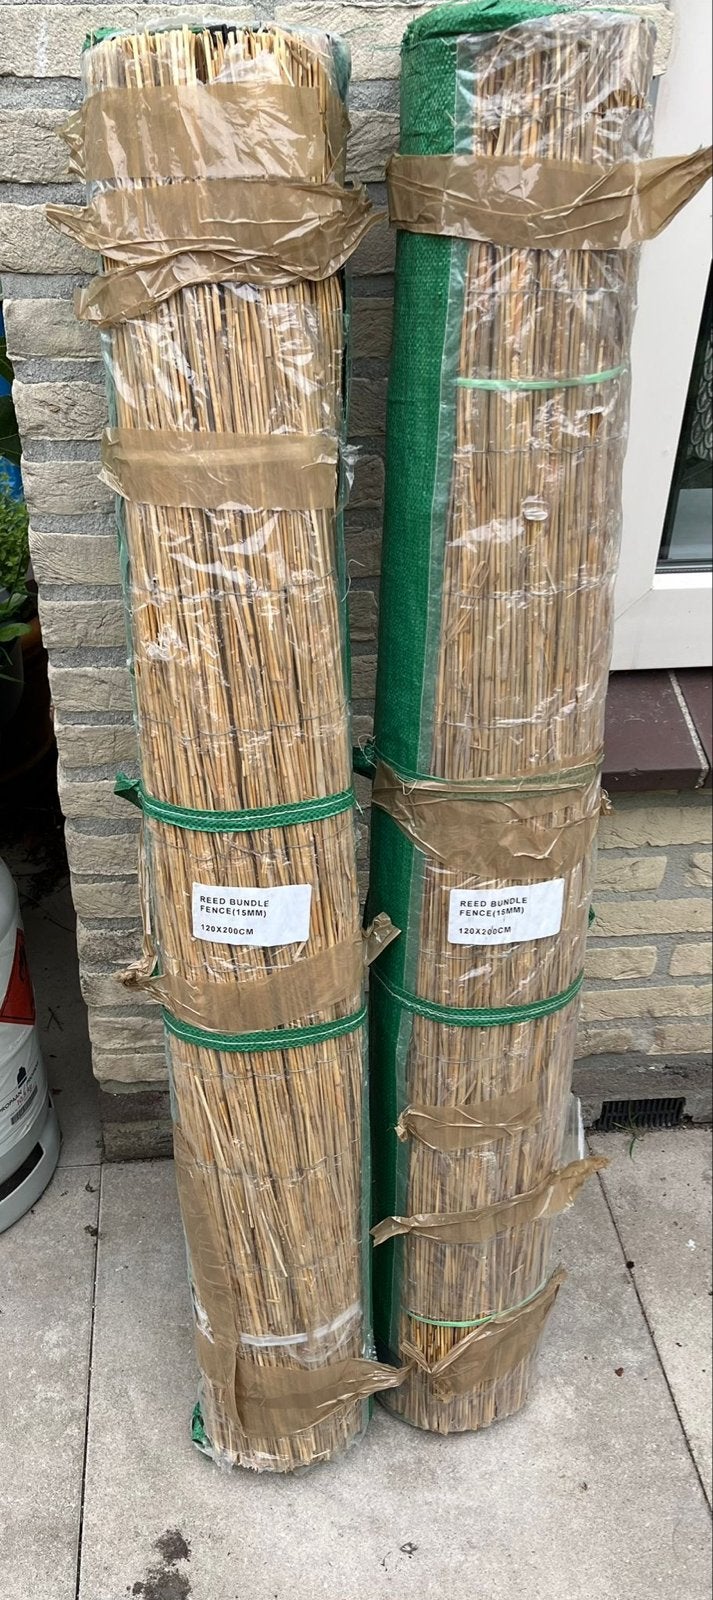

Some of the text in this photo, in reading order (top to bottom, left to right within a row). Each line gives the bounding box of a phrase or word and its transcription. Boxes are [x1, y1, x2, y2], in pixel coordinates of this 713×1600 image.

[200, 896, 270, 908] REED BUNDLE
[460, 898, 528, 908] REED BUNDLE
[200, 905, 267, 917] FENCE(15MM)
[459, 907, 525, 917] FENCE(15MM)
[201, 924, 254, 935] 120X200CM
[459, 927, 511, 935] 120X200CM
